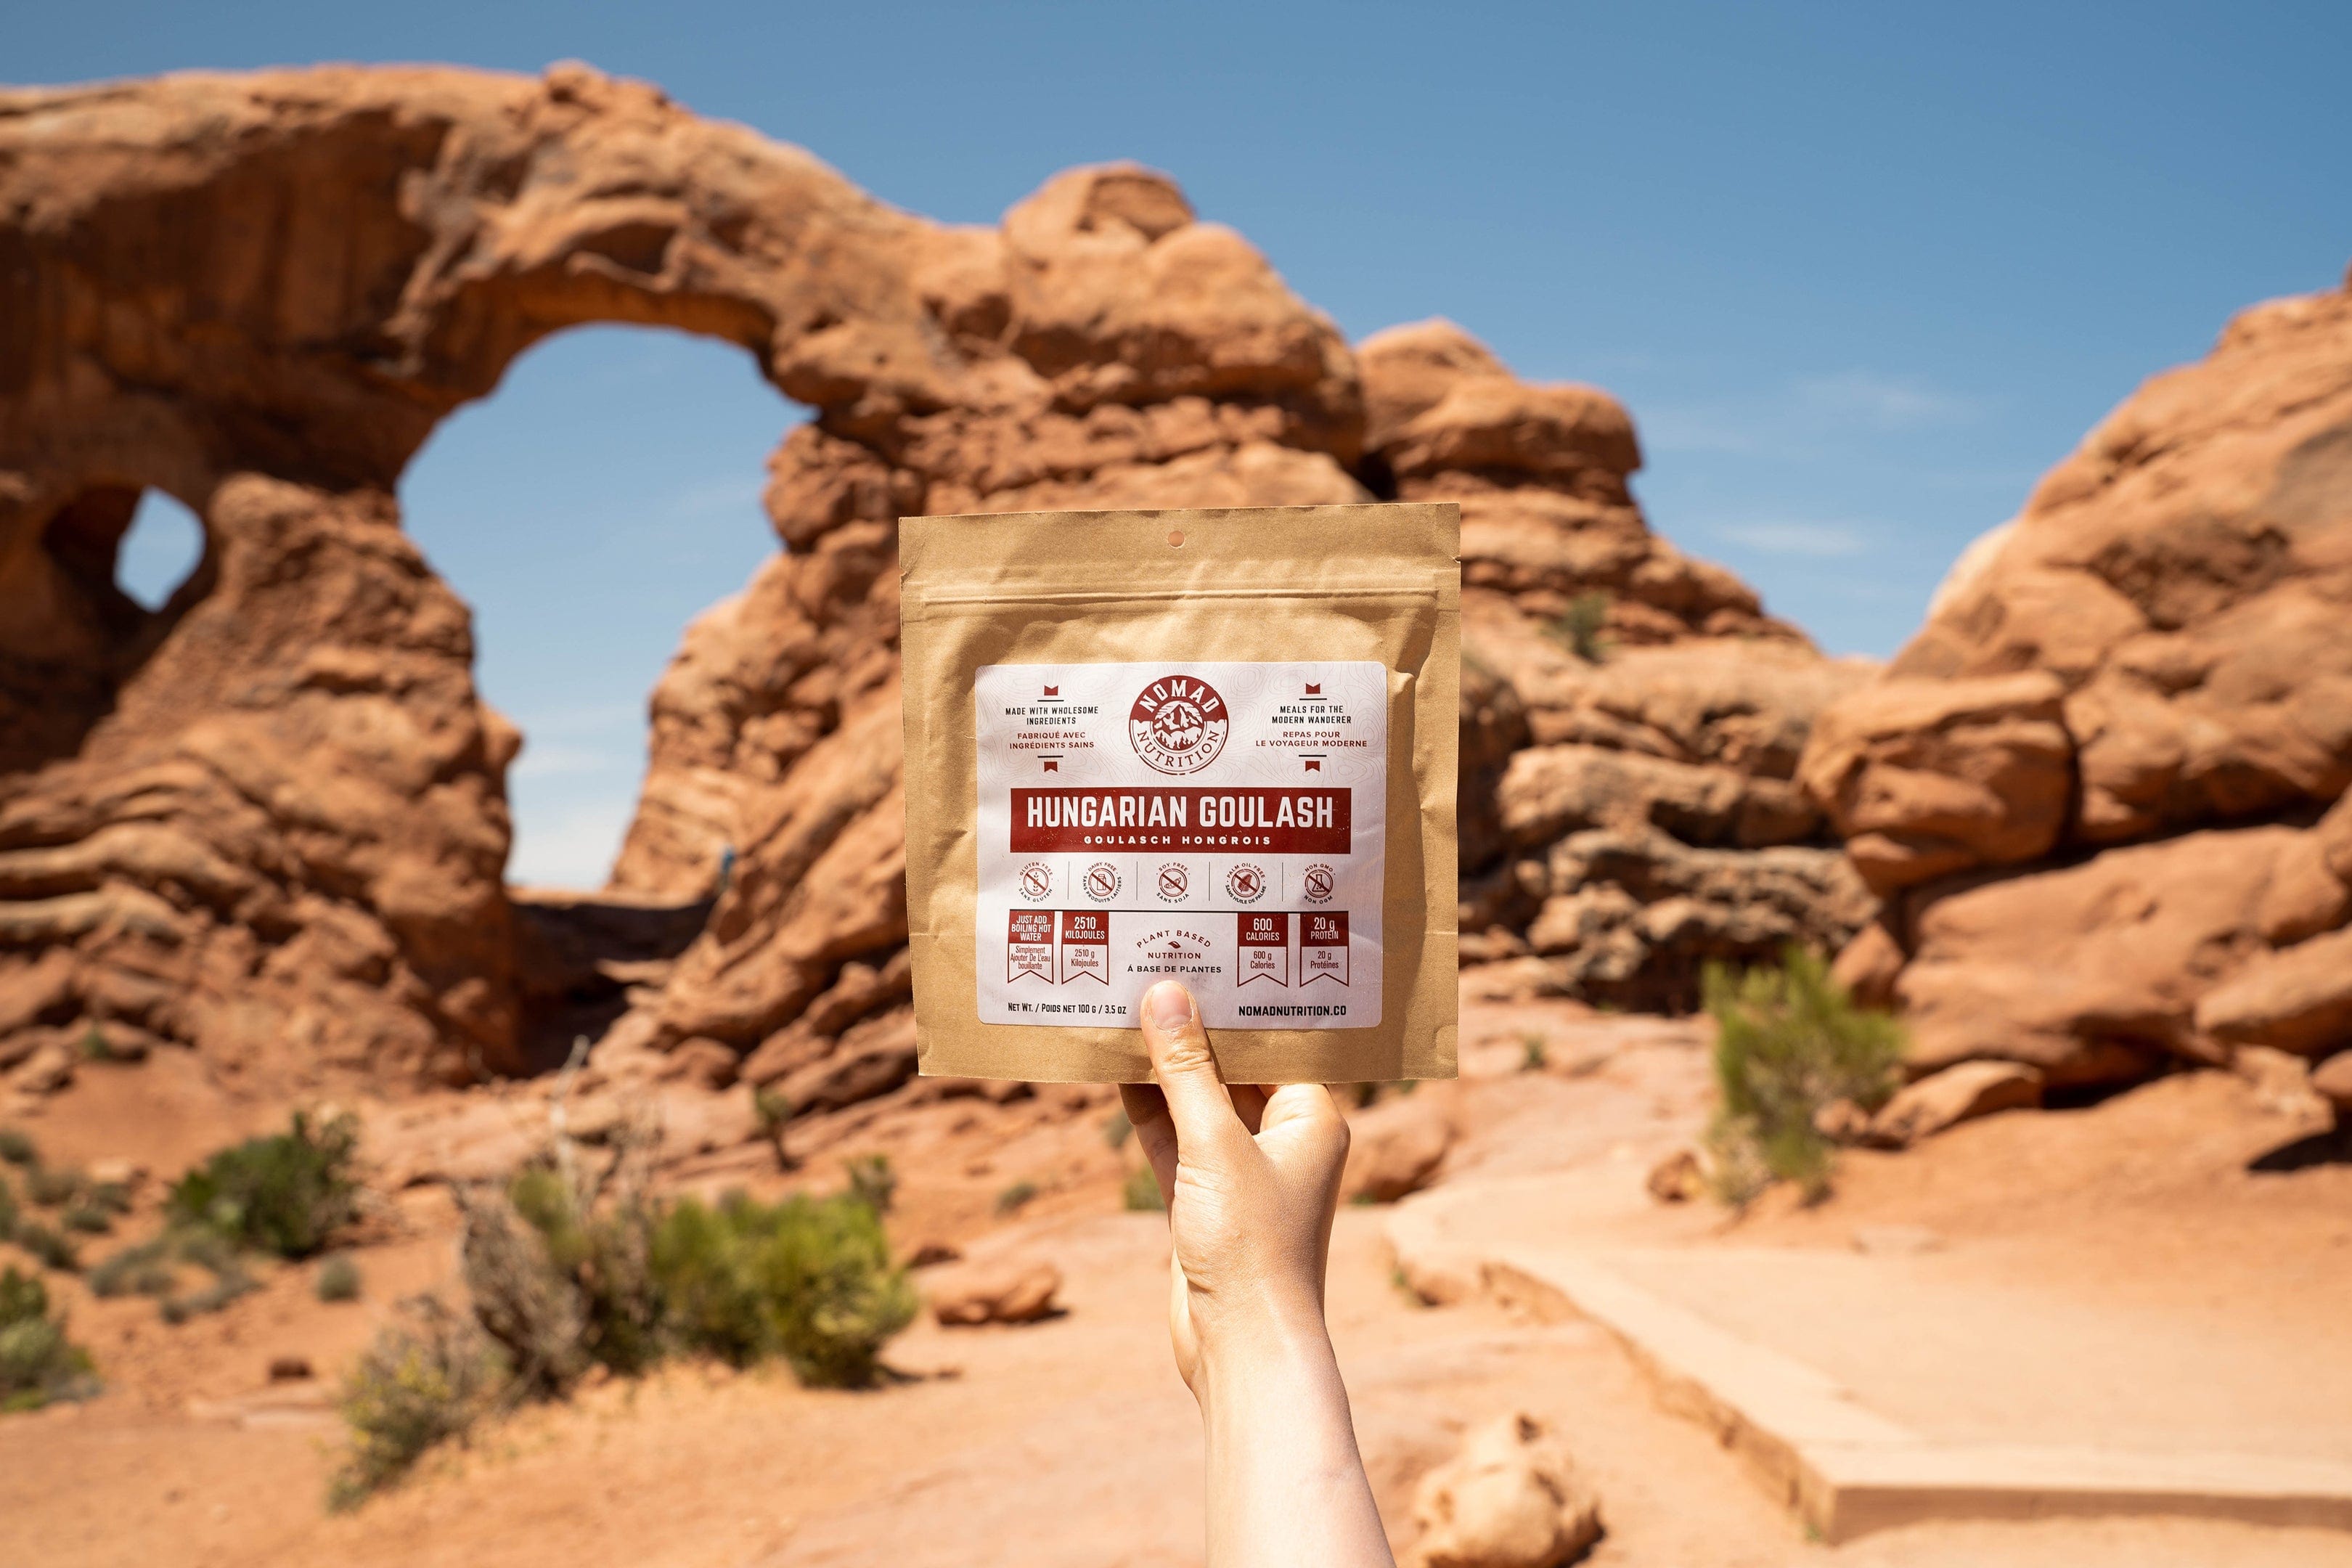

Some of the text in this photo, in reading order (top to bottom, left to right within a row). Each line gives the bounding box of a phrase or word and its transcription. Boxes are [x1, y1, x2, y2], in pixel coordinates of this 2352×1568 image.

[1139, 679, 1220, 713] NOMAD
[1138, 730, 1220, 767] NUTRITION
[1027, 796, 1333, 828] HUNGARIAN GOULASH
[1084, 836, 1270, 845] GOULASCH HONGROIS
[1020, 862, 1039, 875] GLUTEN
[1088, 862, 1116, 871] DAIRY FREE
[1159, 862, 1188, 871] SOY FREE
[1305, 863, 1317, 872] NON
[1227, 865, 1239, 878] PALM
[1254, 865, 1265, 878] FREE
[1018, 888, 1052, 902] SANS GLUTEN
[1086, 891, 1110, 903] PRODUITS
[1156, 892, 1189, 903] SANS SOJA
[1304, 895, 1316, 904] NON
[1016, 915, 1047, 924] JUST ADD
[1074, 916, 1096, 930] 2510
[1011, 924, 1051, 932] BOILING HOT
[1253, 918, 1272, 931] 600
[1314, 917, 1335, 932] 20 g
[1020, 933, 1041, 941] WATER
[1065, 930, 1105, 939] KILOJOULES
[1137, 930, 1211, 948] PLANT BASED
[1246, 932, 1279, 941] CALORIES
[1311, 931, 1338, 940] PROTEIN
[1016, 946, 1045, 954] Simplement
[1075, 949, 1095, 959] 2510 g
[1010, 954, 1028, 962] Ajouter
[1253, 951, 1265, 959] 600
[1318, 951, 1325, 959] 20
[1071, 959, 1099, 968] Kilojoules
[1250, 961, 1275, 969] Calories
[1035, 1003, 1039, 1013] /
[1079, 1004, 1089, 1013] 100
[1099, 1005, 1102, 1014] /
[1105, 1005, 1115, 1014] 3.5
[1239, 1005, 1346, 1016] NOMADNUTRITION.CO
